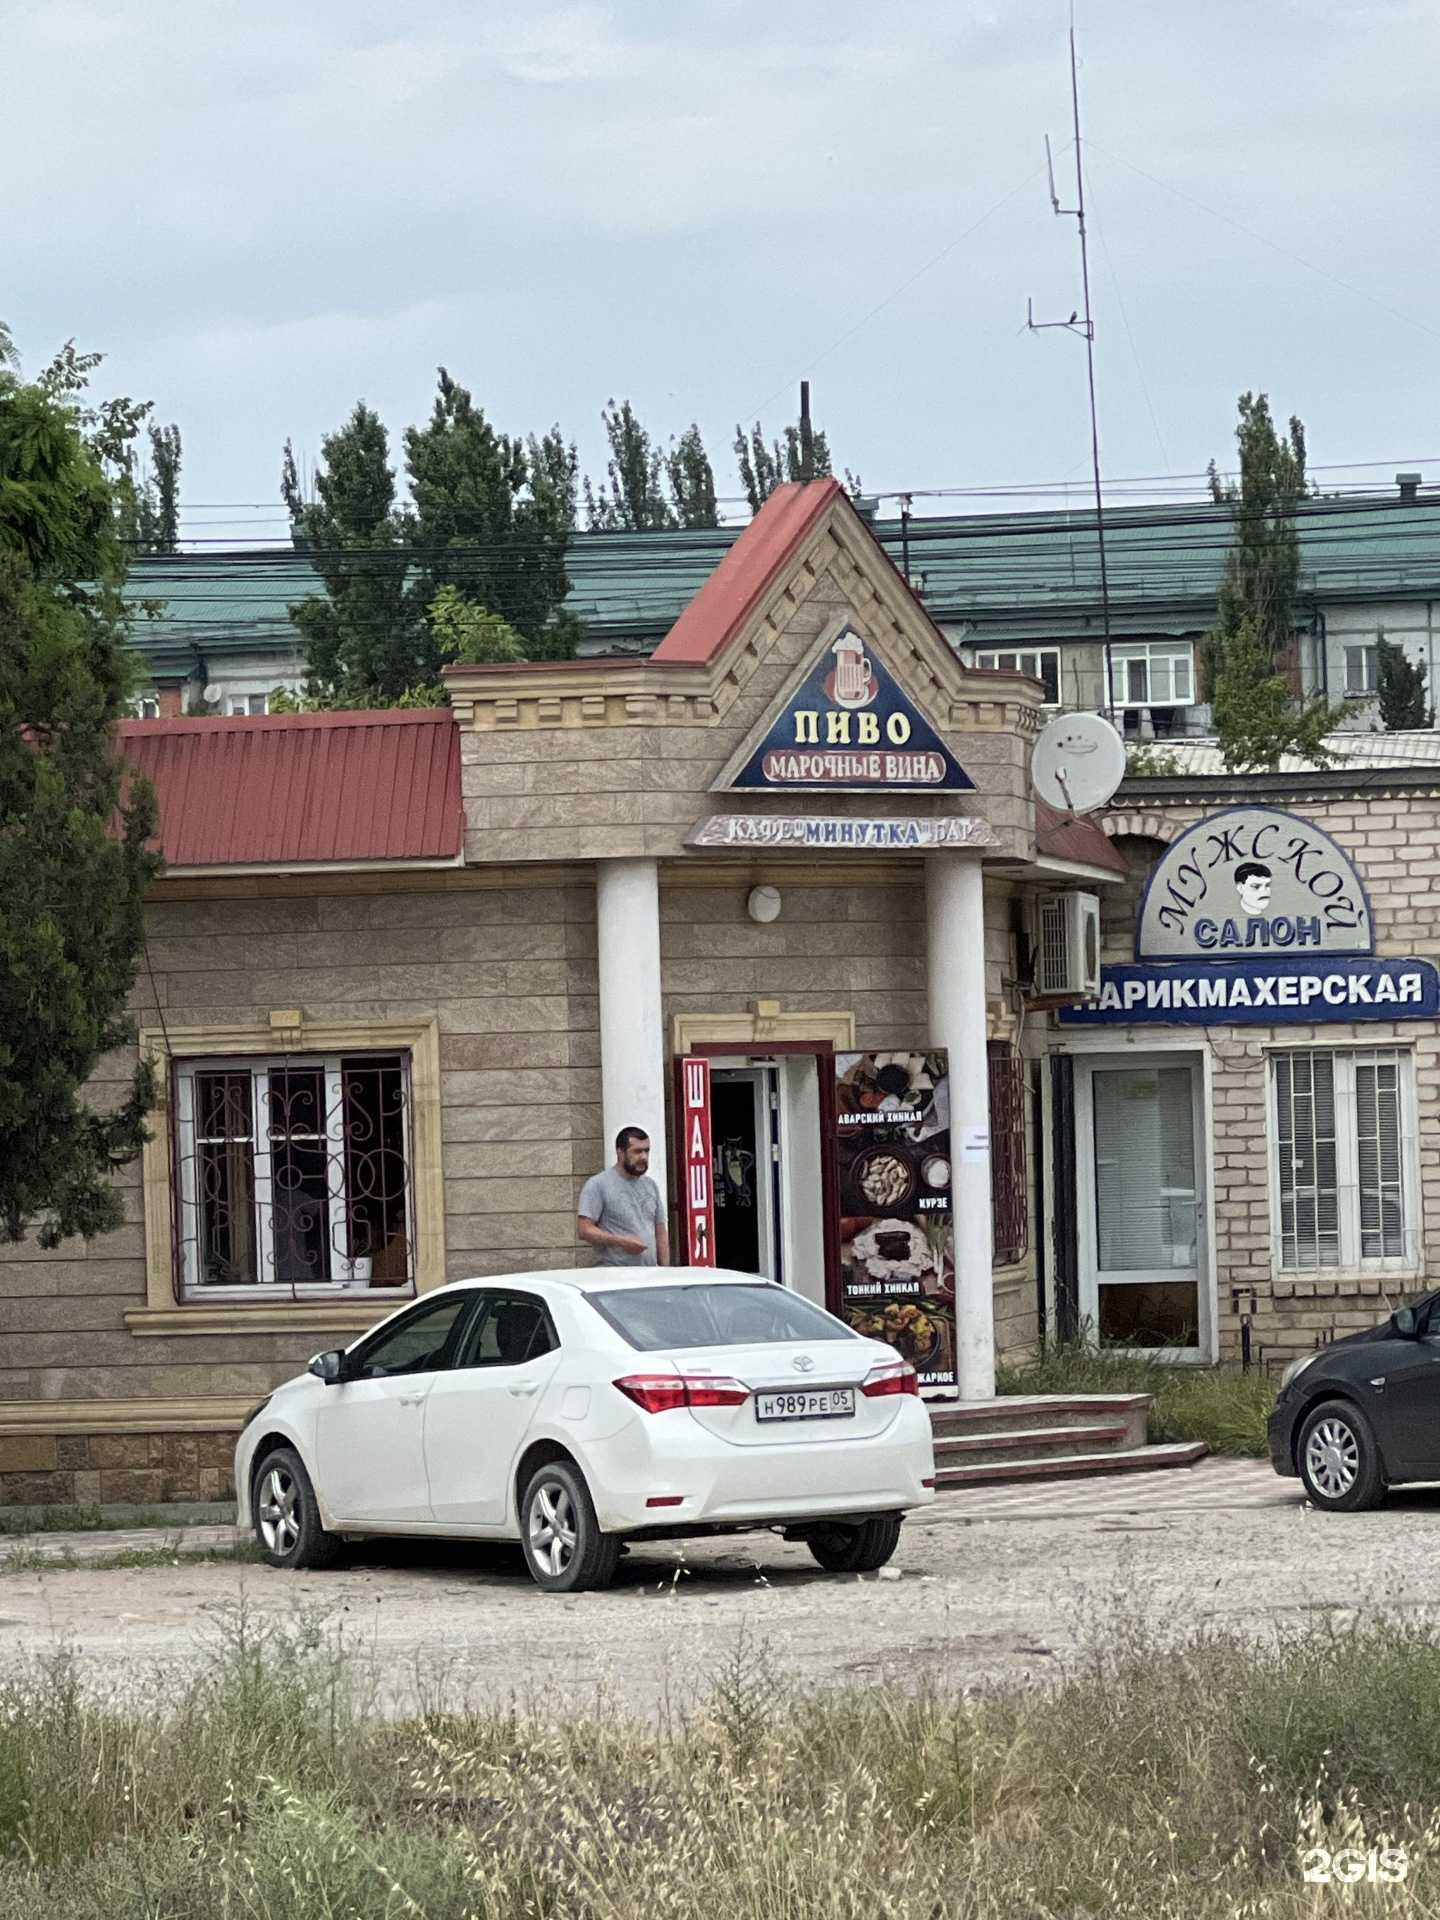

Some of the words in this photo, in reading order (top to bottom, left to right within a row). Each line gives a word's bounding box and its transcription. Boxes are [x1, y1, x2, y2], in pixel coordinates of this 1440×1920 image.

[794, 710, 911, 745] ПИВО
[769, 755, 881, 779] МАРОЧНЫЕ
[885, 755, 940, 780] ВИНА
[1159, 824, 1364, 935] МУЖСКОЙ
[1194, 915, 1321, 948] САЛОН
[838, 1112, 885, 1125] АВАРСКИЙ
[919, 1197, 948, 1209] КУРЗЕ
[846, 1282, 882, 1296] ТОНКИЙ
